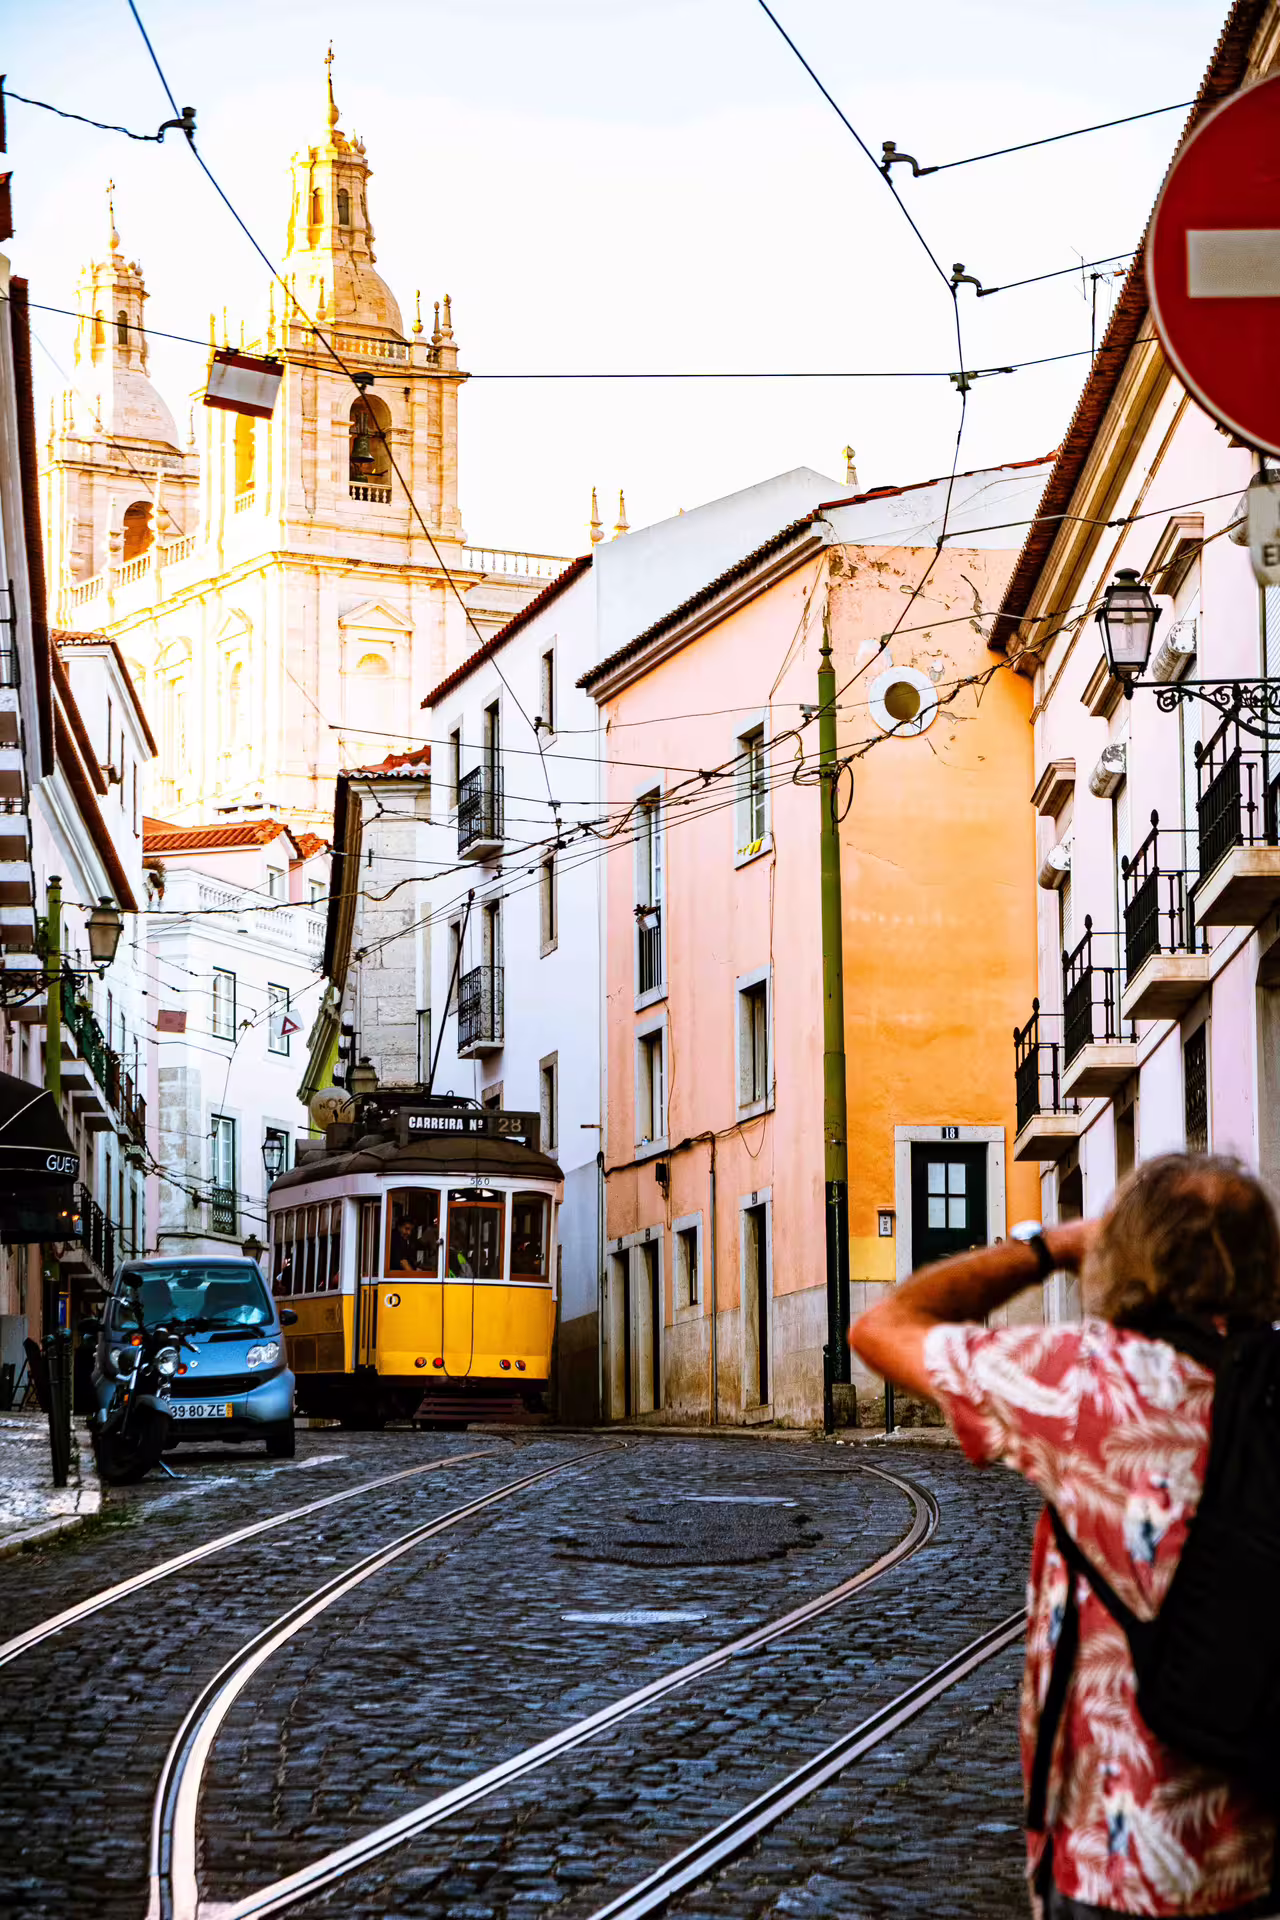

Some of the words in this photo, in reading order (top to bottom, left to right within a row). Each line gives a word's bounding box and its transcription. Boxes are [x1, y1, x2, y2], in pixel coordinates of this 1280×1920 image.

[408, 1116, 464, 1131] CARREIRA
[498, 1118, 521, 1133] 28
[945, 1127, 956, 1139] 18
[470, 1177, 490, 1186] 560
